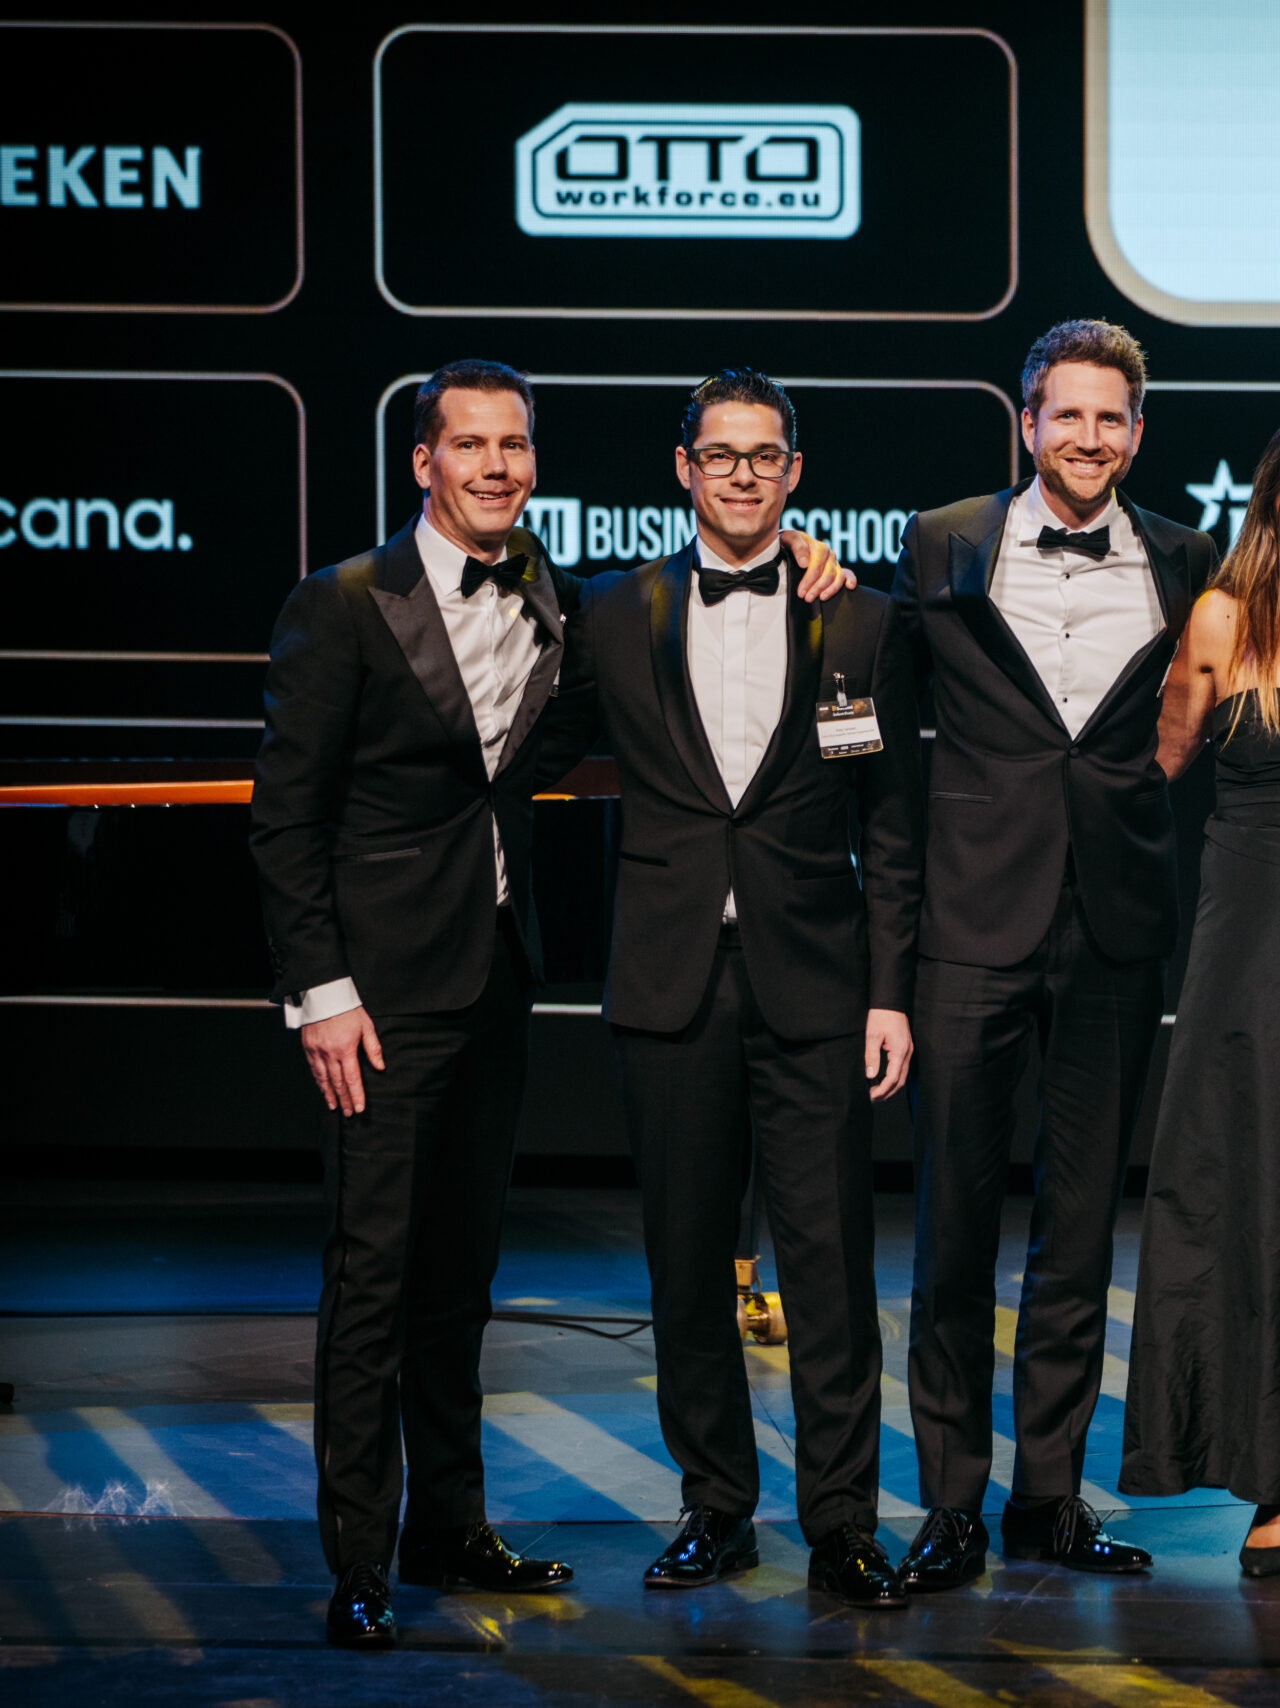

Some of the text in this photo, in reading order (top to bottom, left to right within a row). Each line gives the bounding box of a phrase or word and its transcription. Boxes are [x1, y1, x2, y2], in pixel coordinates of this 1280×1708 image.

[0, 145, 201, 209] EKEN
[555, 134, 820, 182] OTTO
[555, 186, 821, 207] workforce.eu
